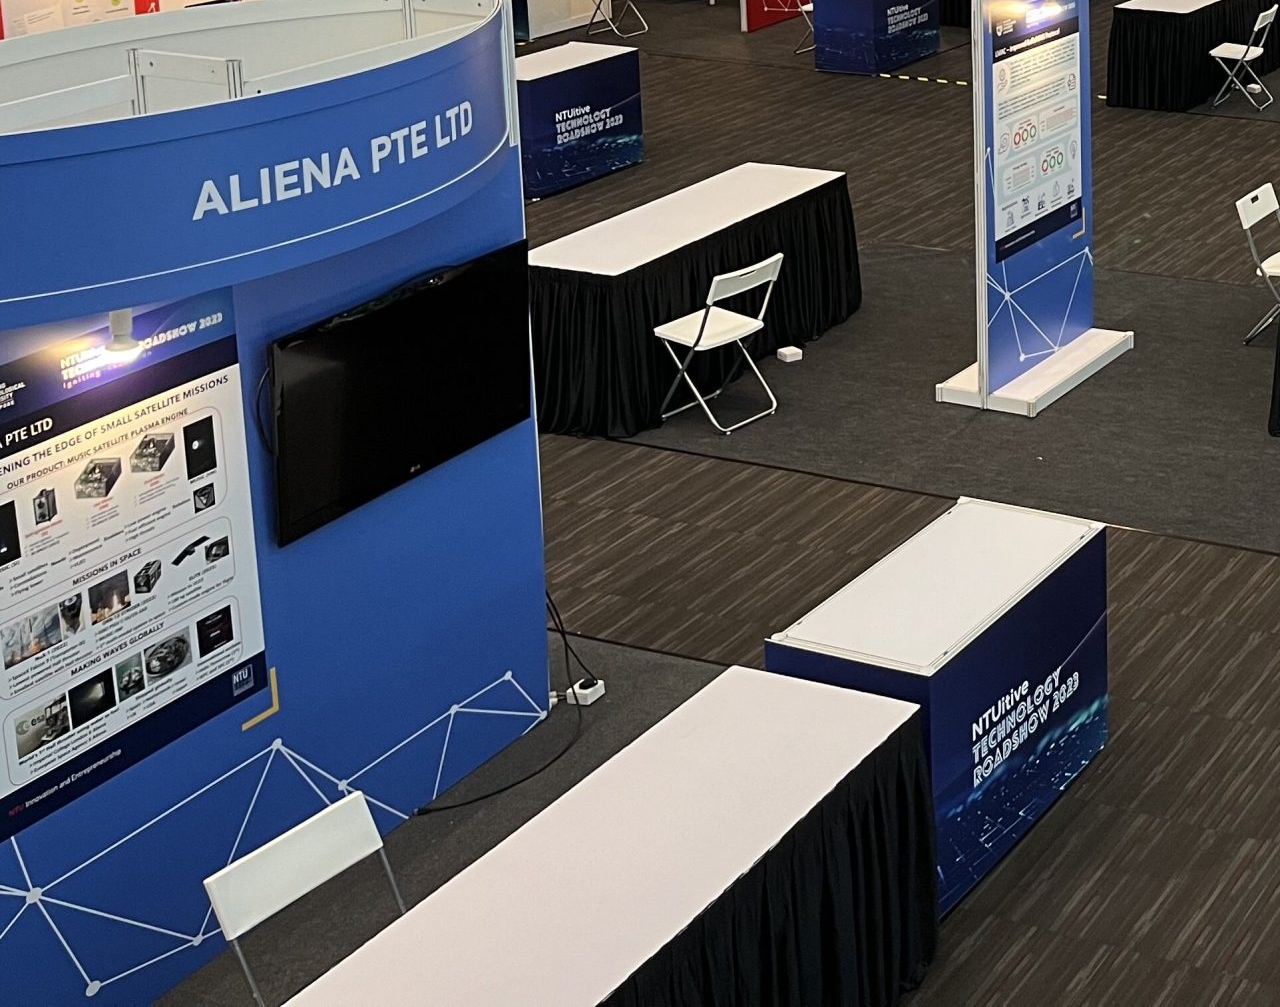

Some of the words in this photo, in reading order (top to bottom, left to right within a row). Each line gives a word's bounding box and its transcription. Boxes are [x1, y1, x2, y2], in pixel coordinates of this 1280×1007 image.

[555, 105, 591, 122] NTUitive
[556, 107, 612, 133] TECHNOLOGY
[556, 121, 605, 145] ROADSHOW
[605, 114, 624, 130] 2023
[192, 147, 361, 221] ALIENA
[371, 120, 429, 174] PTE
[434, 100, 473, 149] LTD
[199, 312, 223, 330] 2023
[5, 426, 28, 445] PTE
[30, 417, 53, 436] LTD
[32, 447, 53, 462] THE
[55, 434, 82, 454] EDGE
[84, 426, 99, 440] OF
[101, 414, 133, 434] SMALL
[134, 394, 181, 421] SATELLITE
[183, 374, 229, 400] MISSIONS
[7, 476, 24, 490] OUR
[67, 450, 91, 464] MUSIC
[93, 433, 129, 455] SATELLITE
[130, 420, 160, 439] PLASMA
[161, 408, 189, 426] ENGINE
[72, 563, 109, 586] MISSIONS
[110, 559, 118, 569] IN
[120, 548, 142, 564] SPACE
[70, 655, 102, 676] MAKING
[103, 642, 128, 659] WAVES
[129, 622, 165, 645] GLOBALLY
[233, 669, 249, 684] NTU
[972, 680, 1029, 742] NTUitive
[972, 666, 1062, 764] TECHNOLOGY
[973, 699, 1050, 788] ROADSHOW
[1052, 671, 1080, 713] 2023
[25, 785, 59, 808] Innovation
[59, 777, 71, 789] and
[71, 749, 122, 782] Entrepreneurship
